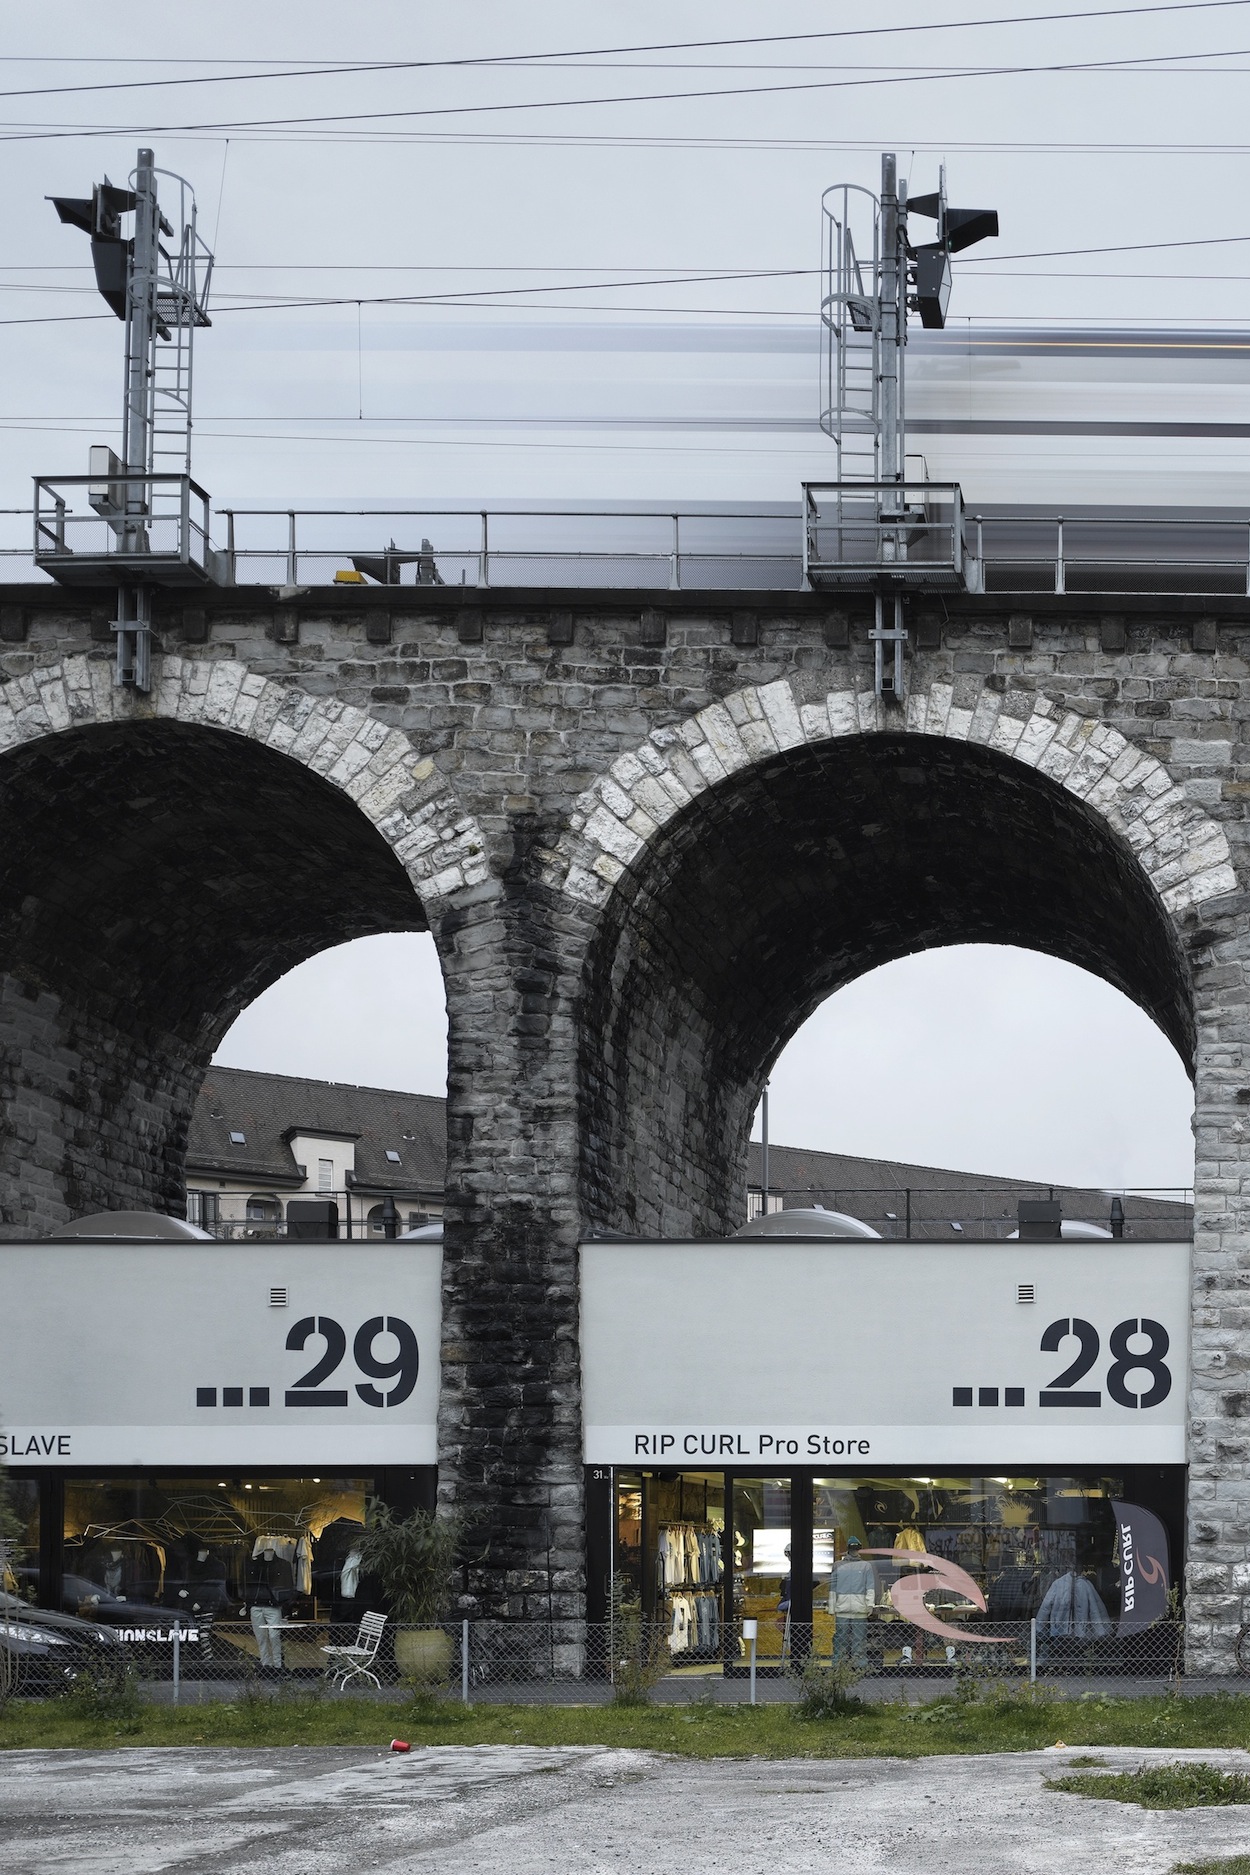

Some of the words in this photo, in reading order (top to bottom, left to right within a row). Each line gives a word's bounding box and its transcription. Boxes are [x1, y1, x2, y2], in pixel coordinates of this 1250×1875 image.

[635, 1434, 675, 1455] RIP
[683, 1434, 751, 1455] CURL
[759, 1434, 799, 1455] Pro
[806, 1434, 870, 1455] Store
[593, 1469, 603, 1480] 31
